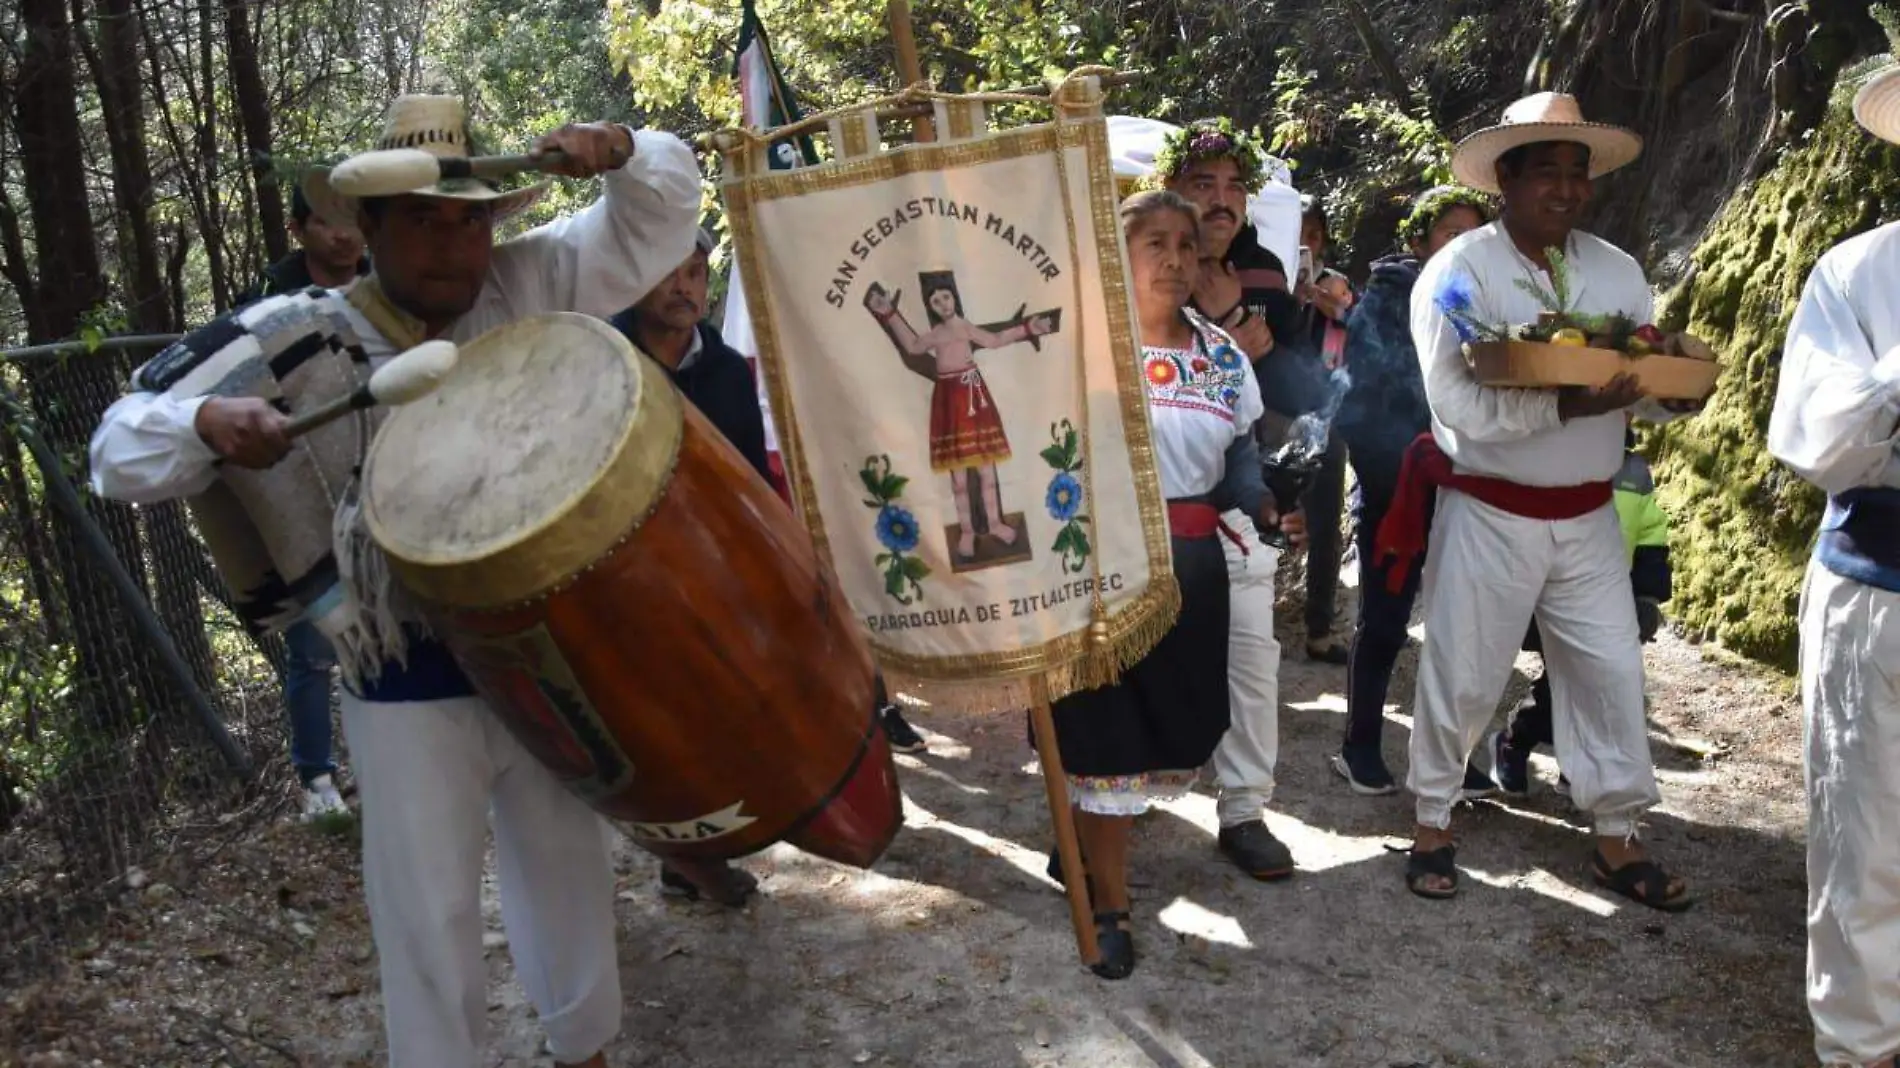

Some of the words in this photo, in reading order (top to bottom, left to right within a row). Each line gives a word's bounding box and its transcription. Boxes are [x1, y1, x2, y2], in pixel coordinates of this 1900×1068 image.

[826, 260, 858, 308] SAN
[851, 197, 979, 260] SEBASTIAN
[986, 212, 1061, 283] MARTIR
[867, 605, 970, 632] PARROQUIA
[977, 603, 1001, 622] DE
[1009, 573, 1124, 617] ZITLALTEPEC
